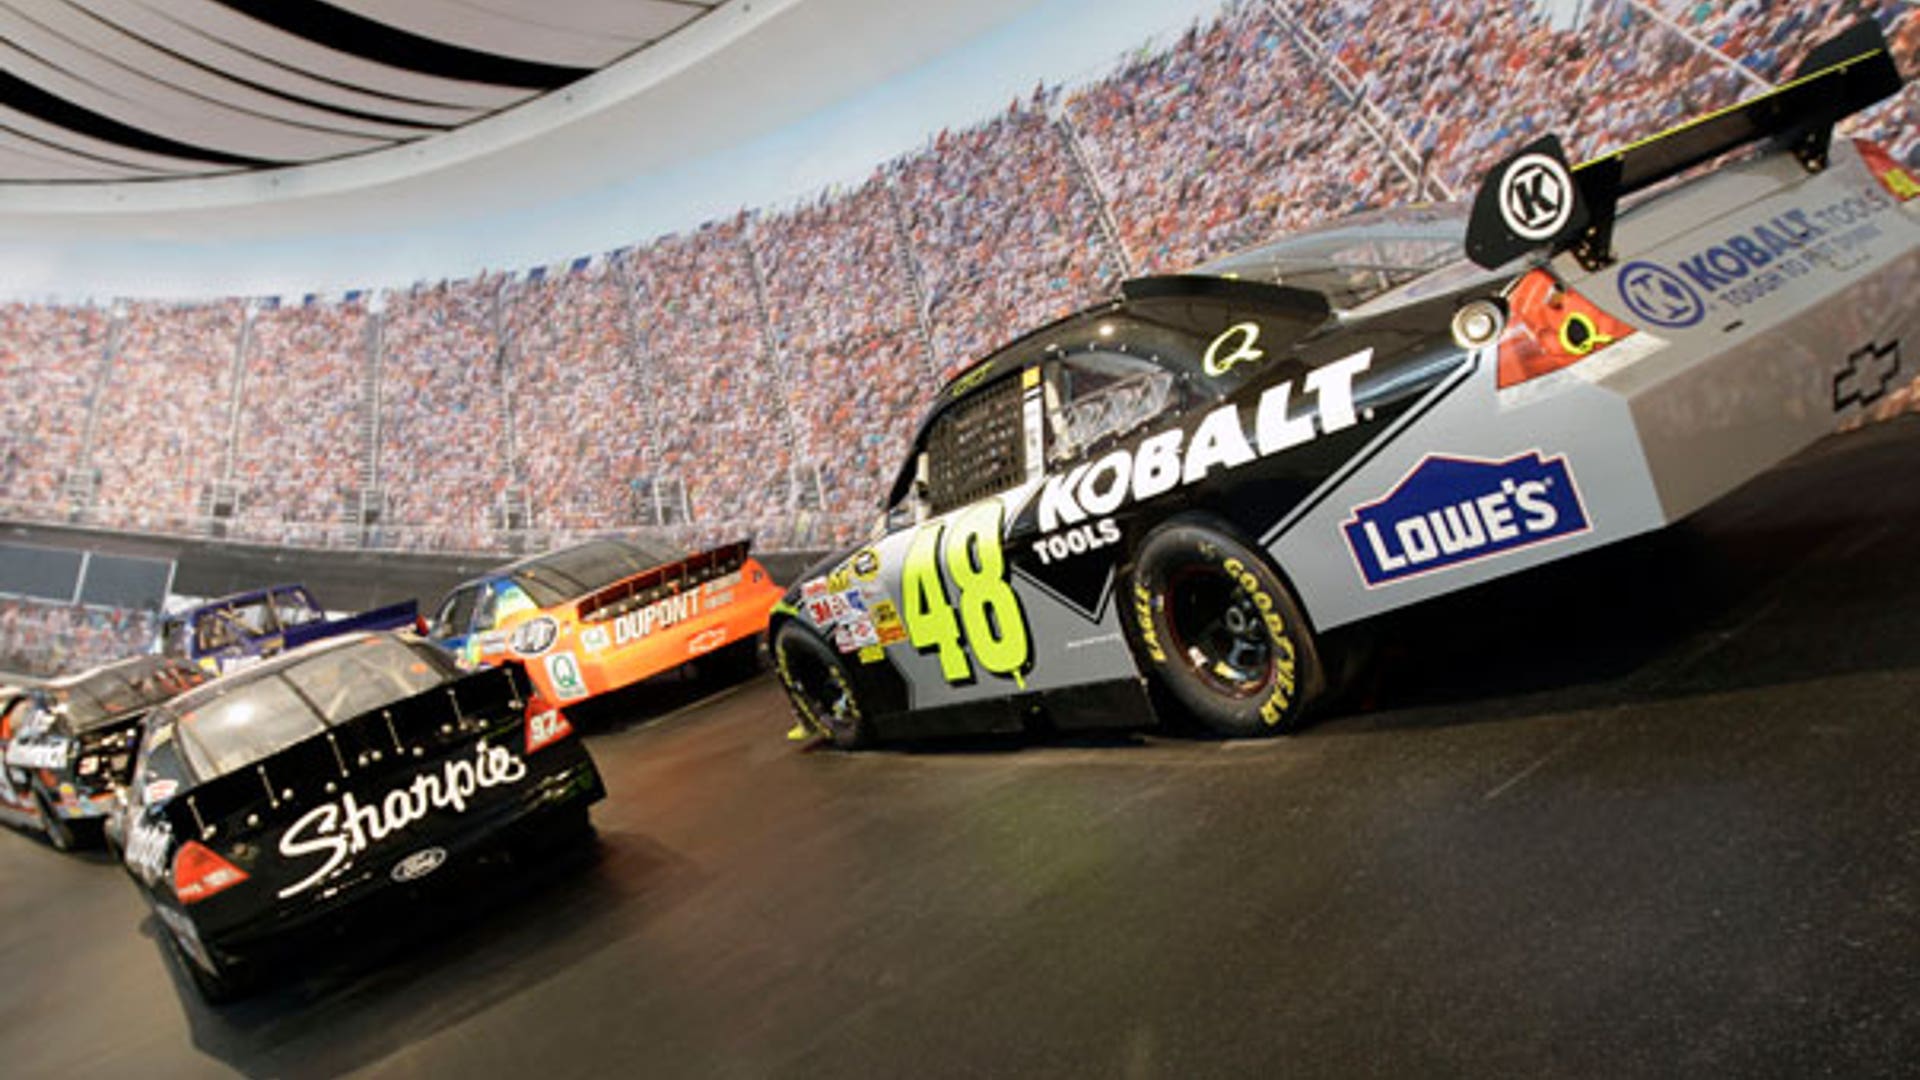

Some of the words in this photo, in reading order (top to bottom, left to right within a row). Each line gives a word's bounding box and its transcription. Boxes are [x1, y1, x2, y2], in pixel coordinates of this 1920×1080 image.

[1677, 207, 1826, 294] KOBALT
[1037, 347, 1376, 533] KOBALT
[1032, 517, 1122, 566] TOOLS
[1362, 477, 1558, 572] LOWE'S
[613, 588, 701, 646] DUPONT
[902, 497, 1034, 686] 48
[1134, 582, 1167, 662] EAGLE
[1223, 557, 1295, 727] GOODYEAR
[277, 737, 527, 899] Sharpie
